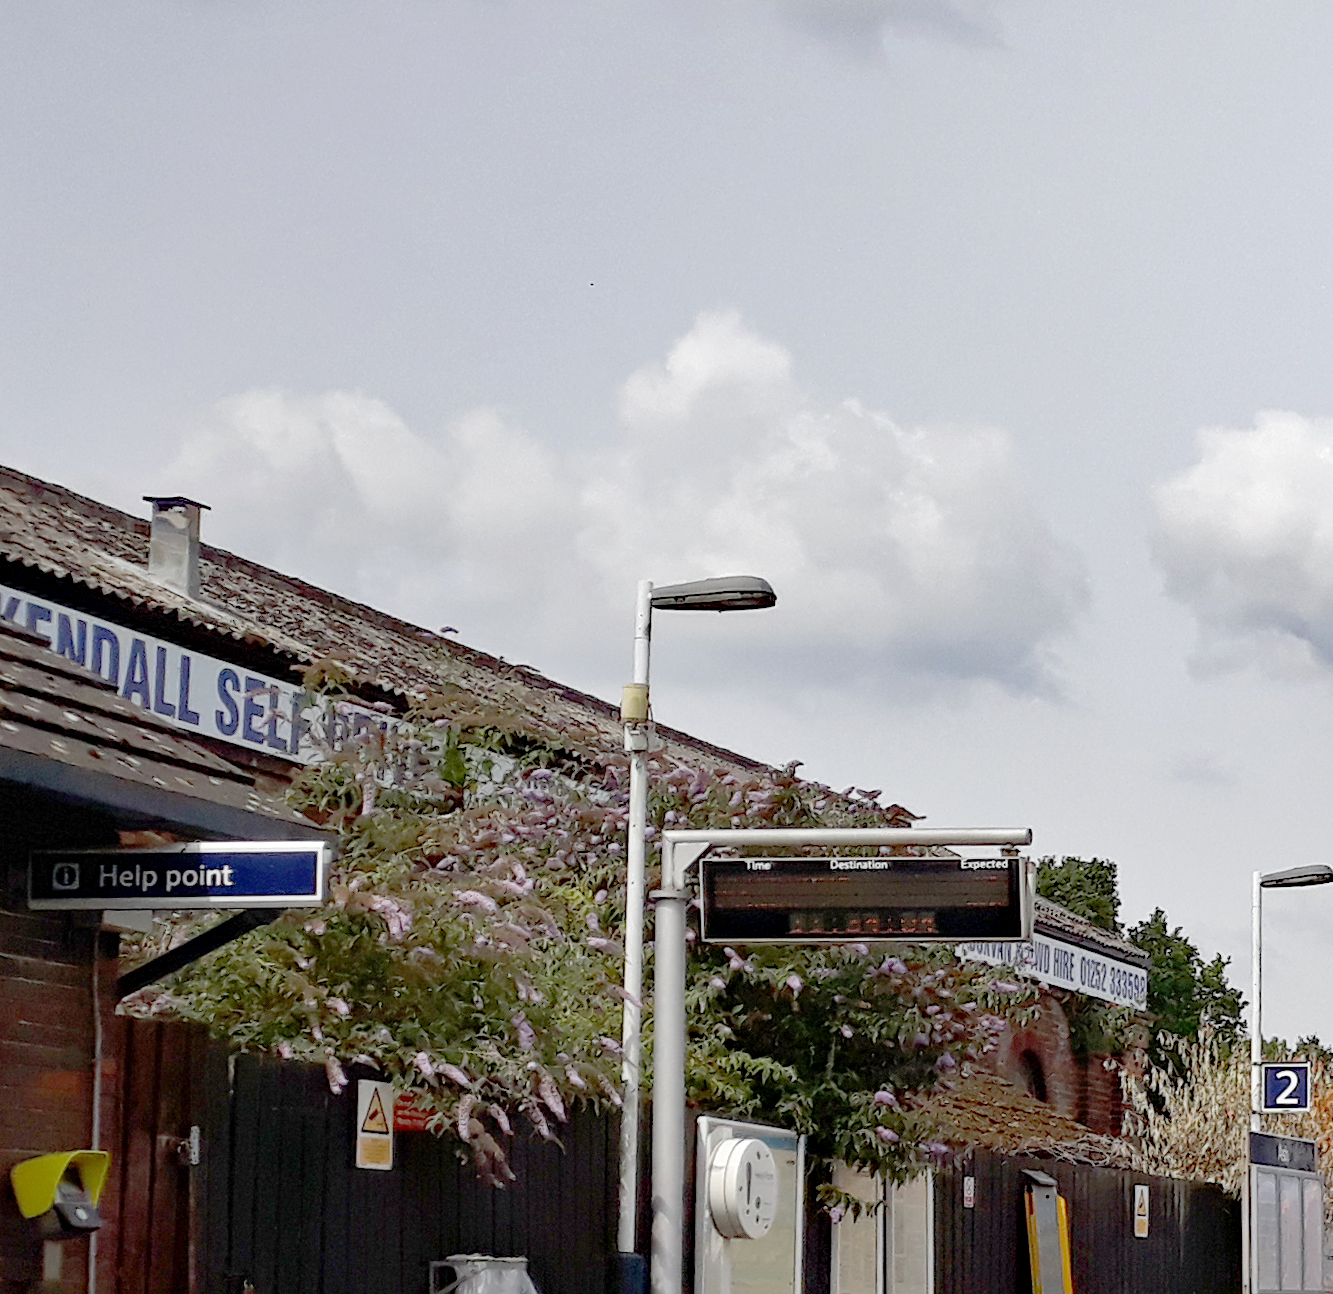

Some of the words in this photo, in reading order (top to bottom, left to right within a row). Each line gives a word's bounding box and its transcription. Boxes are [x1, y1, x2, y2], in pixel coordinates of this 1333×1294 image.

[0, 595, 200, 725] NDALL
[99, 864, 158, 892] Help
[165, 864, 235, 892] point
[745, 860, 772, 871] Time
[830, 859, 889, 870] Destination
[960, 859, 1009, 871] Expected
[1054, 947, 1075, 982] HIRE
[1080, 956, 1106, 992] 01252
[1275, 1069, 1299, 1105] 2
